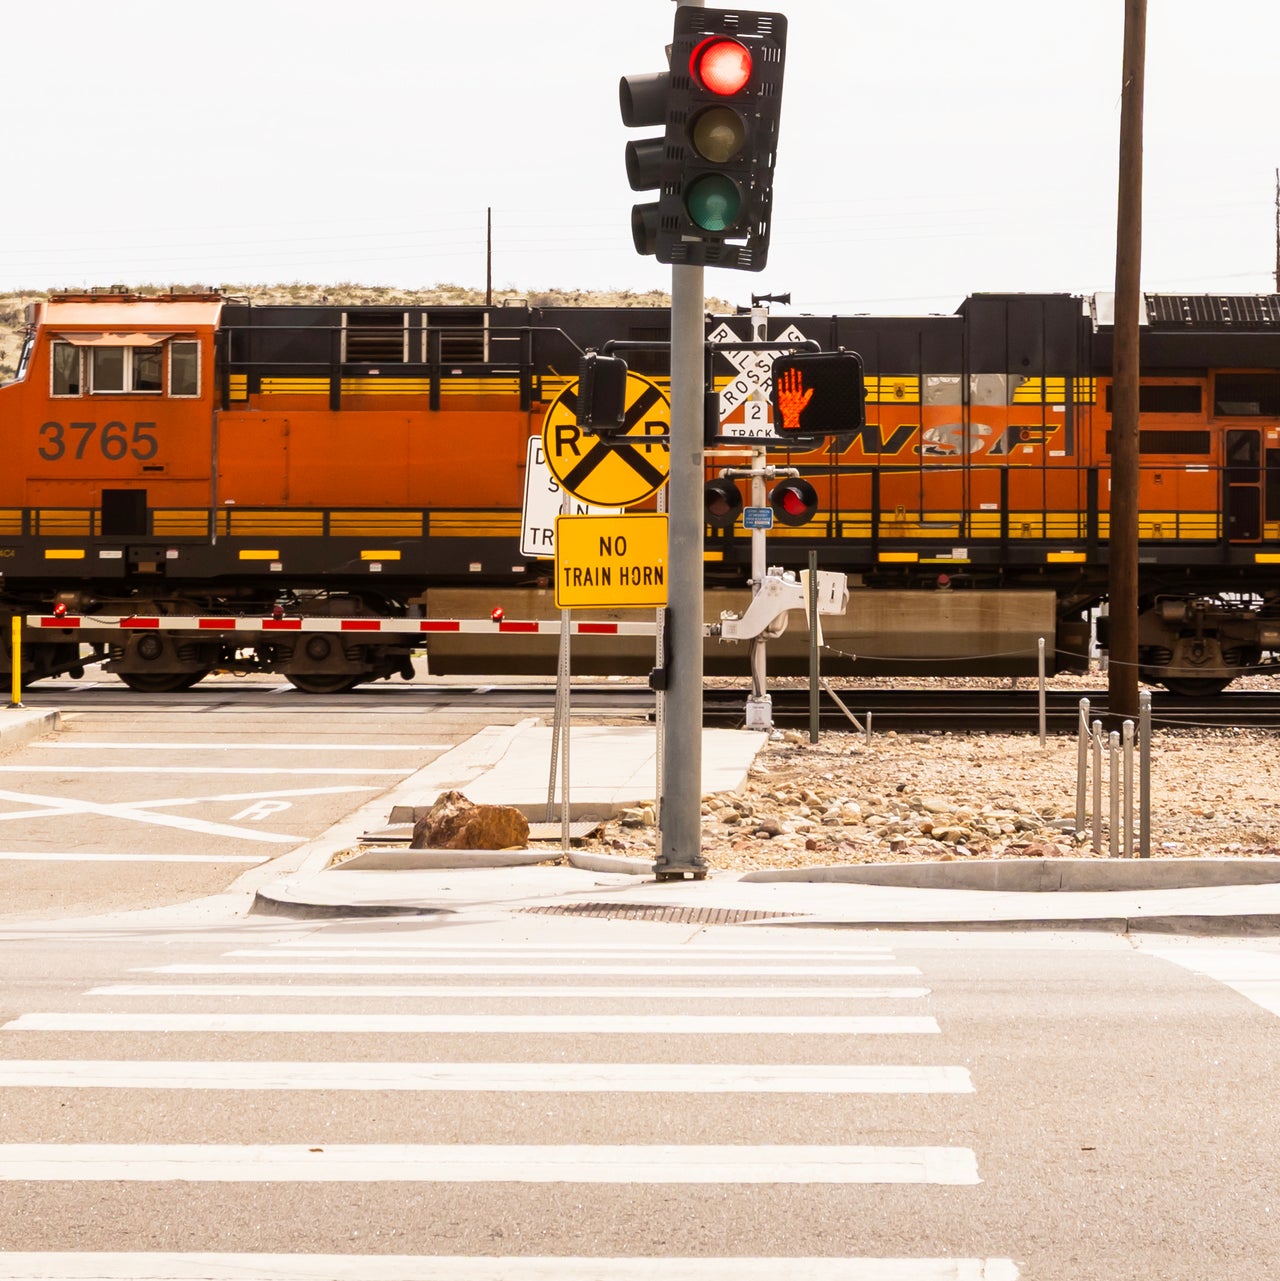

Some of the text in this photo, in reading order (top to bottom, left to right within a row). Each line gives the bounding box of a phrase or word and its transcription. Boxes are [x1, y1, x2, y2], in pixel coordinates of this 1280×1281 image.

[751, 405, 761, 420] 2
[38, 421, 158, 461] 3765
[555, 421, 670, 457] R R
[766, 423, 1062, 457] NSF
[599, 536, 627, 557] NO
[564, 566, 664, 587] TRAIN HORN
